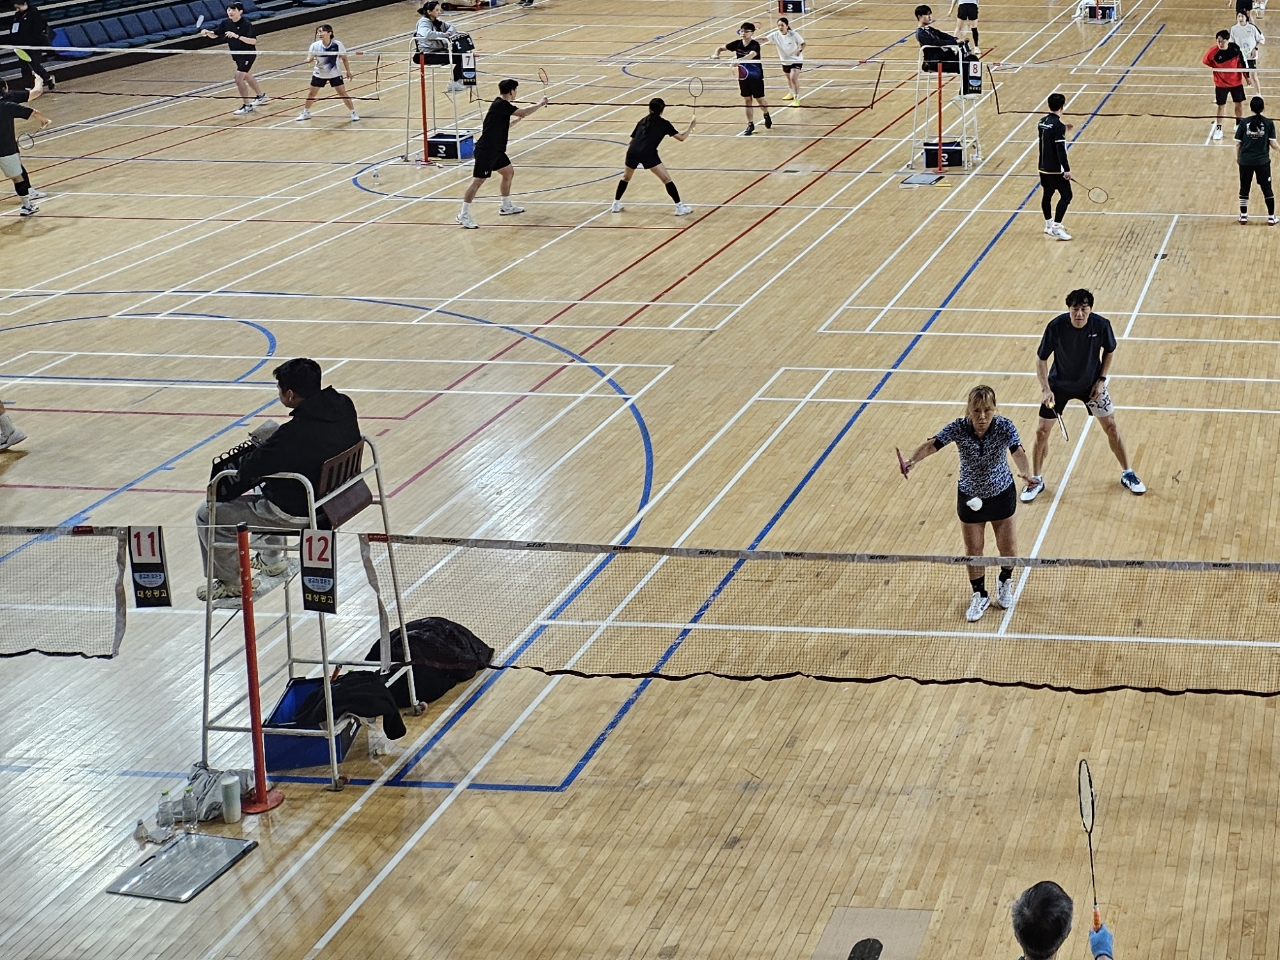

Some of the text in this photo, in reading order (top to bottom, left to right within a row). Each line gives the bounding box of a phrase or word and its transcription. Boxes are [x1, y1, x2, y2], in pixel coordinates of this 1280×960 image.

[465, 55, 470, 66] 7
[973, 63, 978, 74] 8
[134, 531, 156, 557] 11
[305, 535, 330, 562] 12
[305, 593, 334, 604] 대상광고
